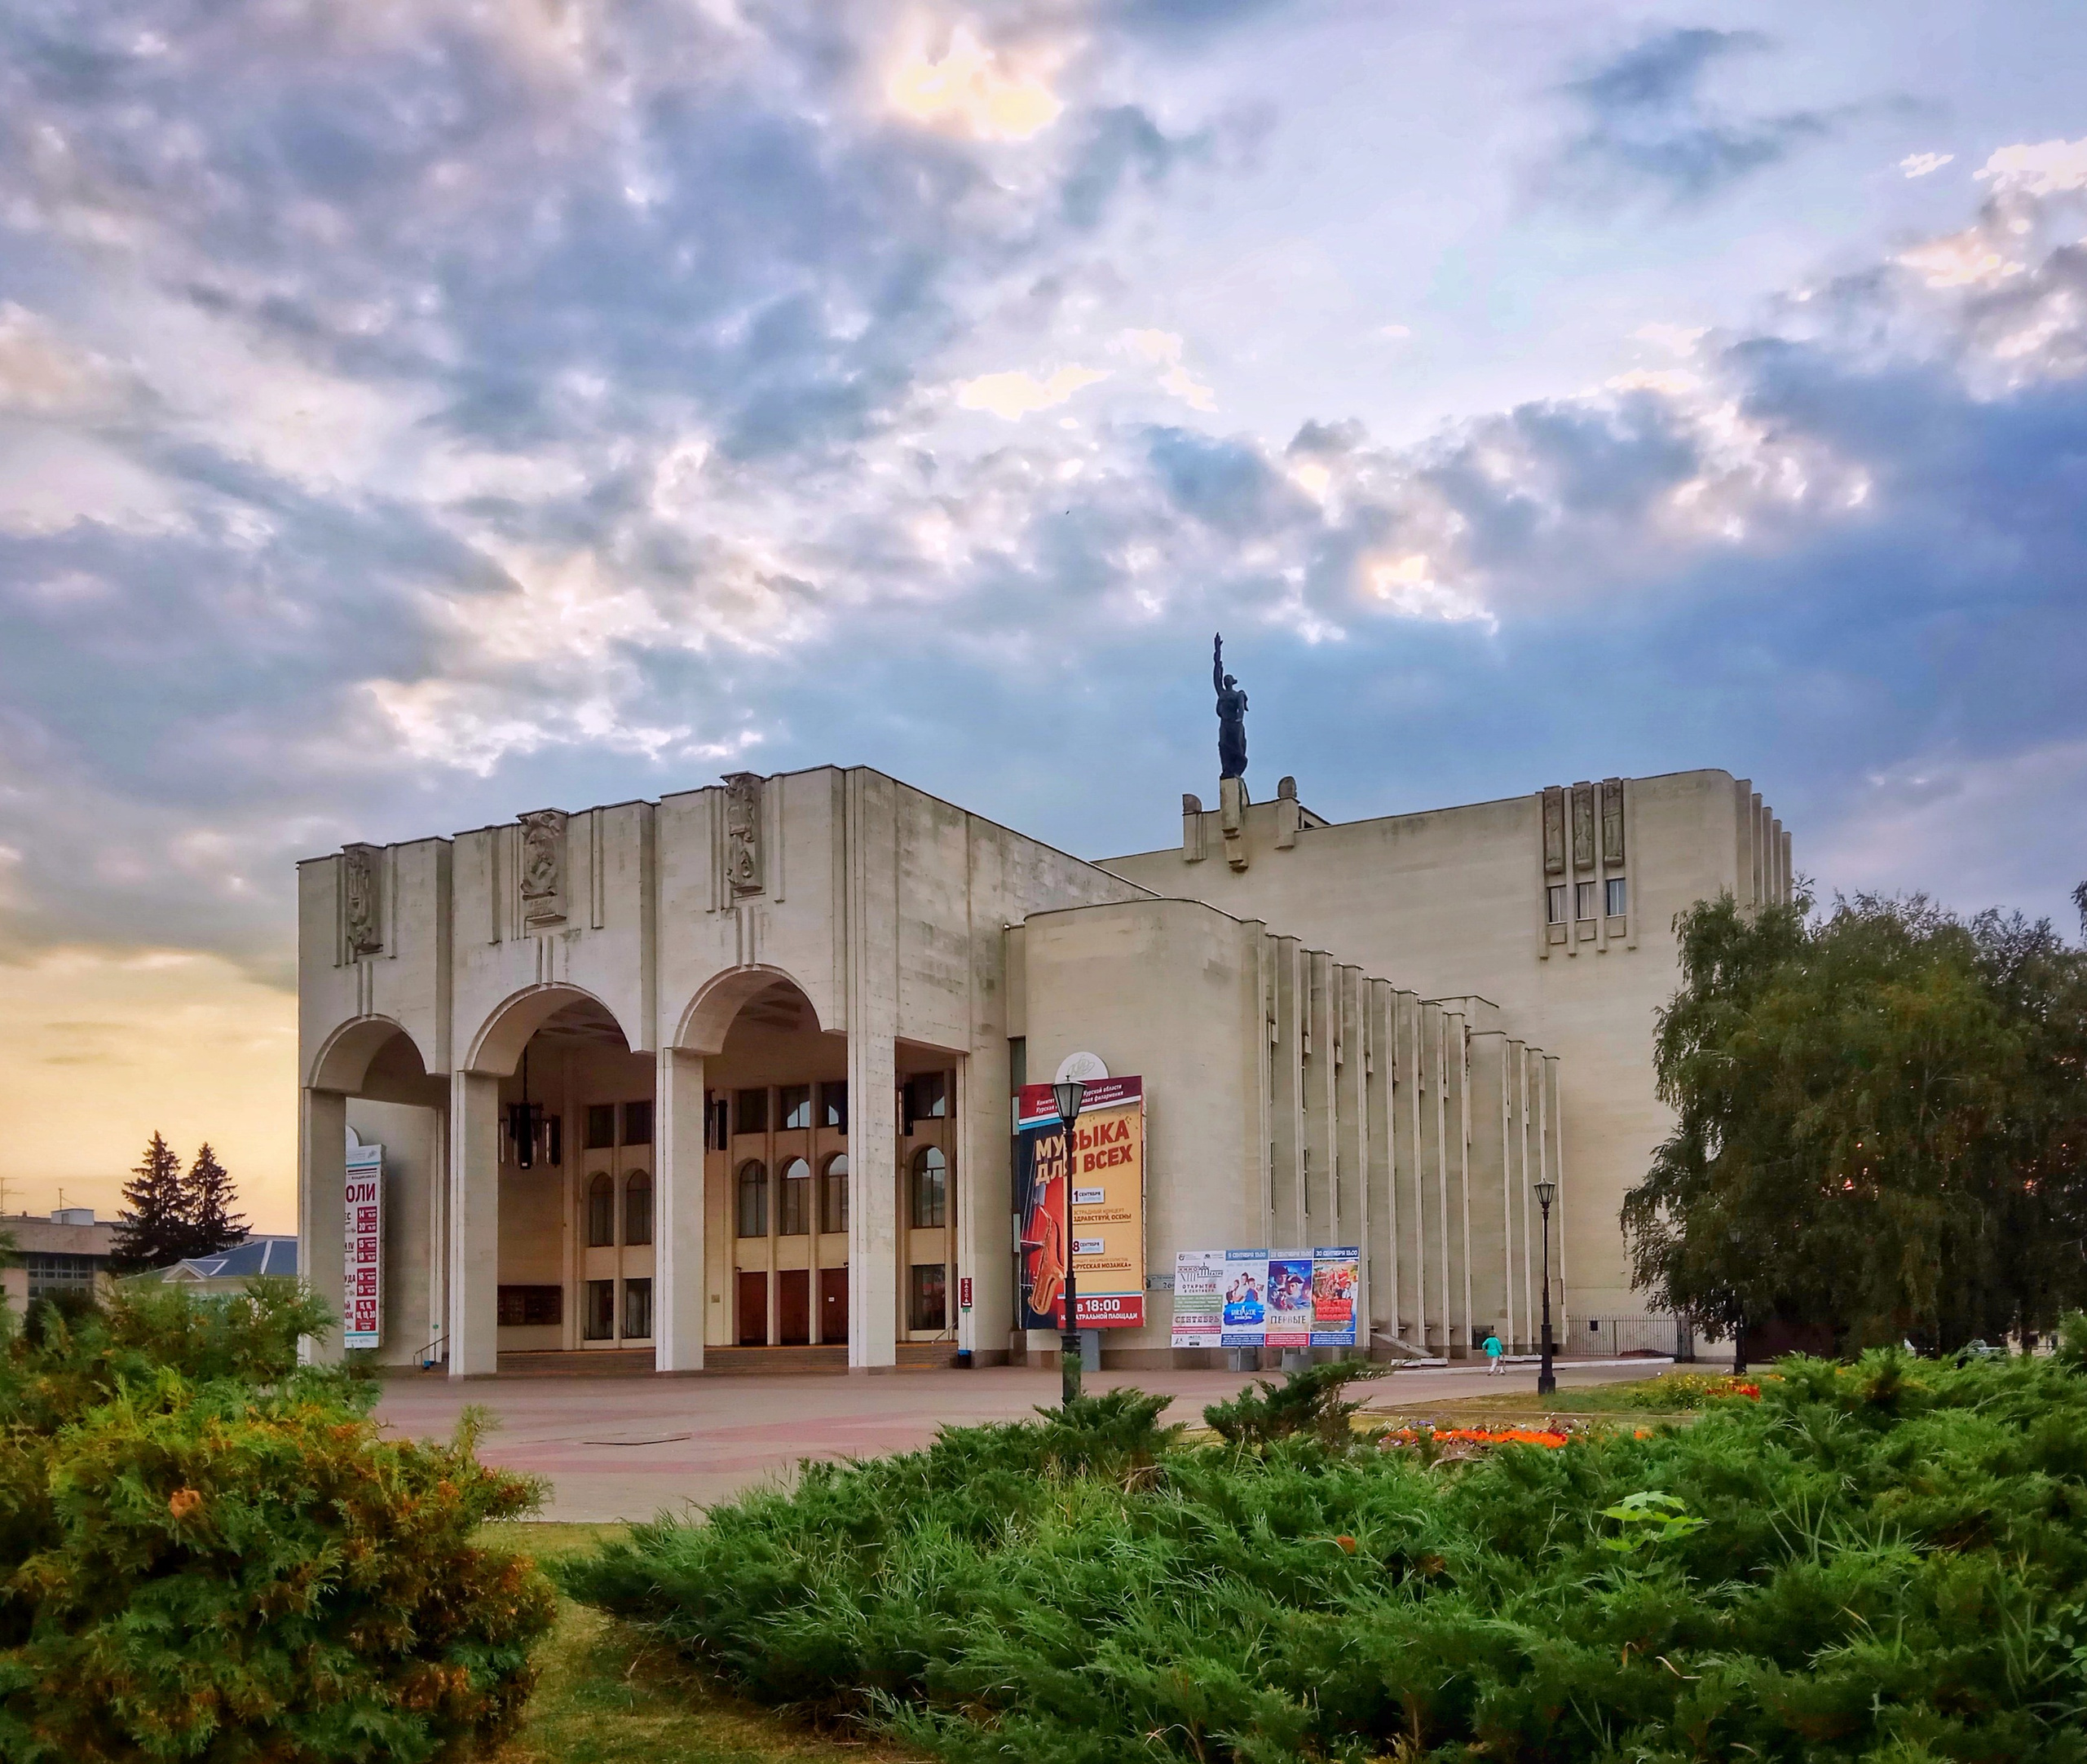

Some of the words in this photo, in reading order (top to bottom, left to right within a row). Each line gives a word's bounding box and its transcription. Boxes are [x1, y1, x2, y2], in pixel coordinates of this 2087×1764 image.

[1083, 1144, 1133, 1173] ВСЕХ
[1074, 1190, 1079, 1202] 1
[1073, 1241, 1080, 1252] 8
[1085, 1299, 1120, 1312] 18:00
[1075, 1312, 1108, 1320] АТРАЛЬНОЙ
[1270, 1315, 1306, 1324] ПЕРВЫЕ
